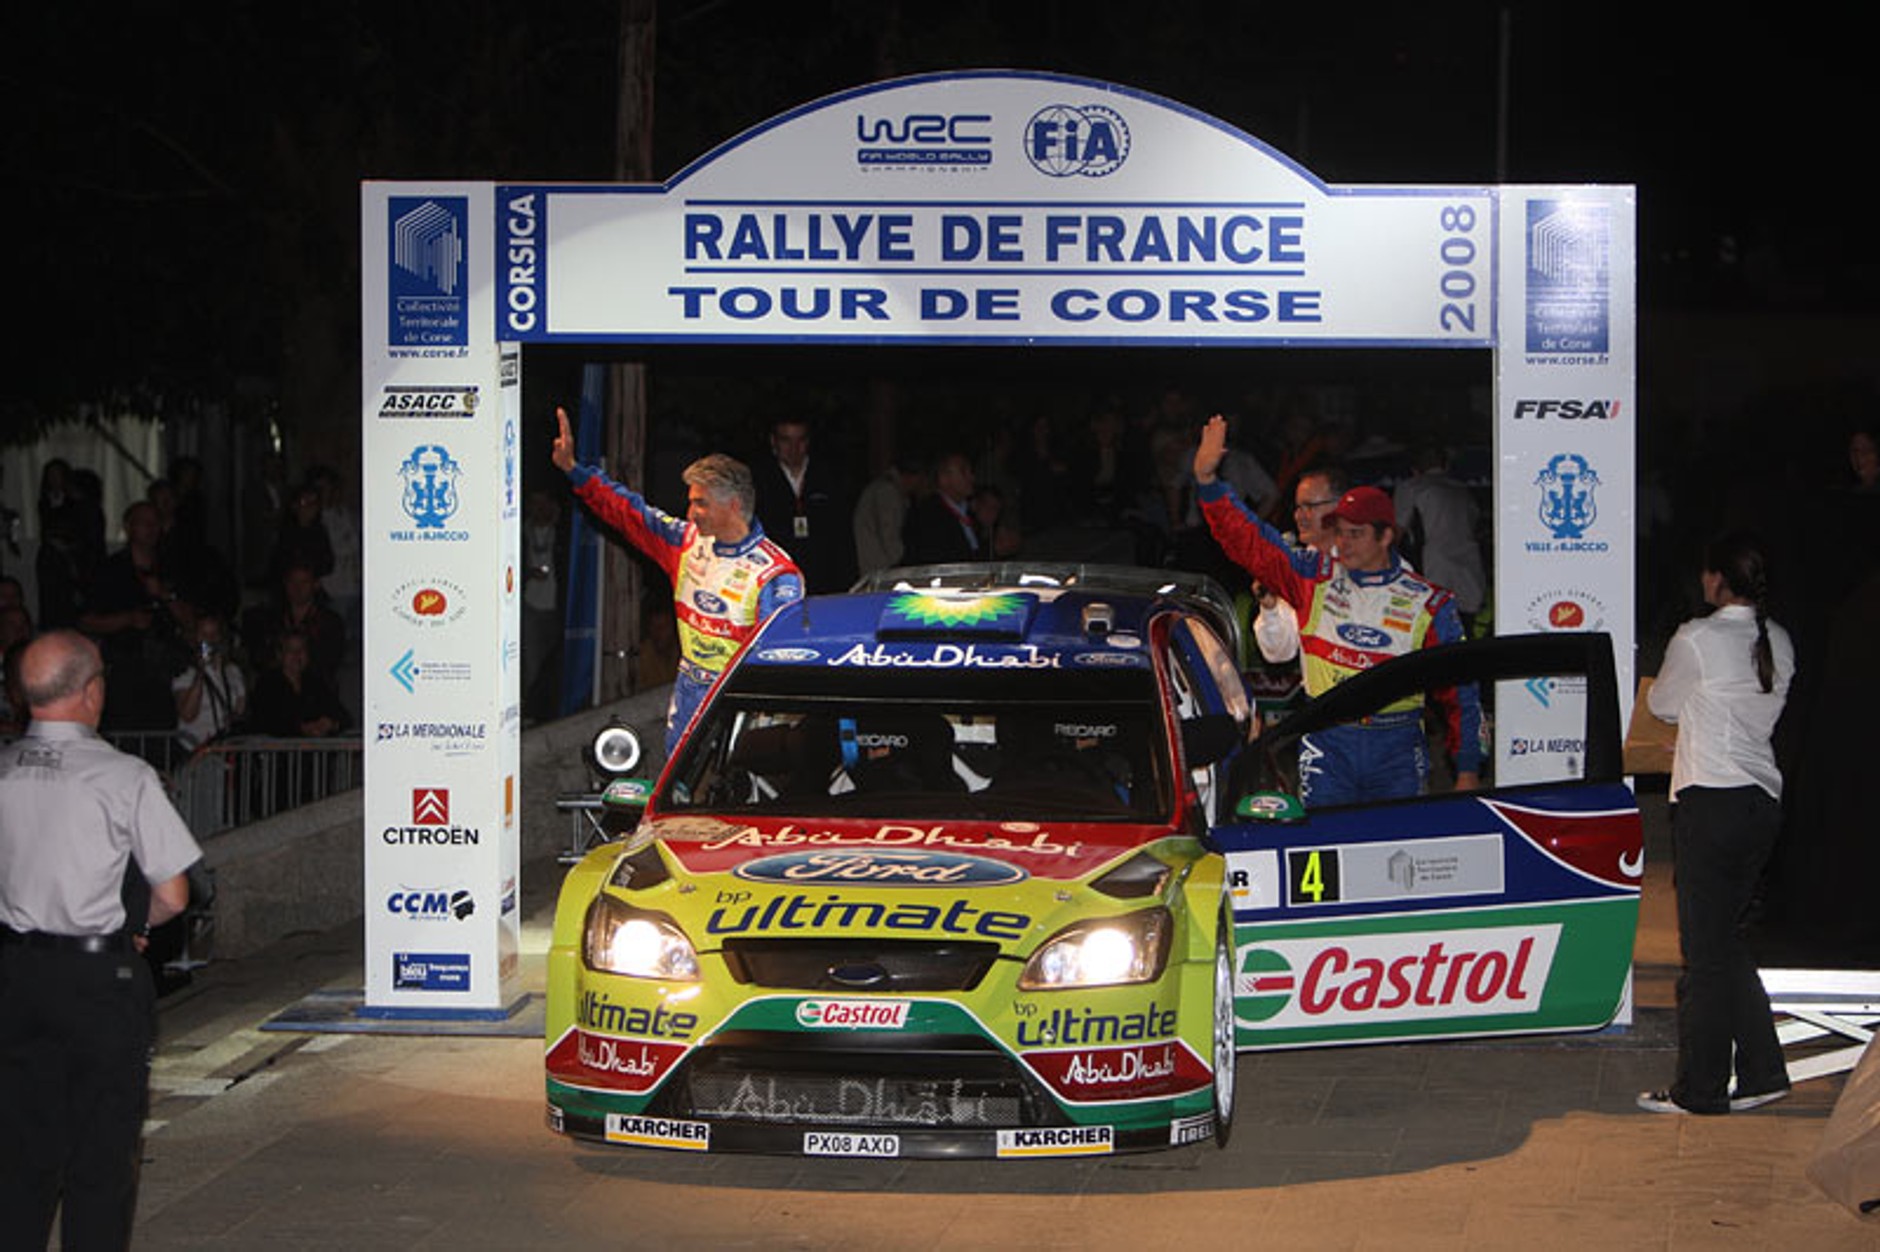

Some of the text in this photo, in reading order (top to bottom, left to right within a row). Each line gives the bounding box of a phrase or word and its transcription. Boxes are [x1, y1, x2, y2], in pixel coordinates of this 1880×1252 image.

[858, 115, 991, 143] WRC
[684, 213, 1305, 264] RALLYE DE FRANCE
[508, 194, 536, 332] CORSICA
[1440, 204, 1476, 332] 2008
[668, 286, 1322, 323] TOUR DE CORSE
[383, 394, 456, 409] ASACC
[1344, 628, 1381, 645] Ford
[857, 734, 908, 747] ECARO
[383, 825, 479, 845] CITROËN
[785, 852, 972, 883] Ford
[1300, 850, 1325, 903] 4
[387, 892, 448, 913] CCM
[706, 894, 1032, 940] ultimate
[1299, 936, 1535, 1016] Castrol
[820, 1003, 902, 1027] Castrol
[1017, 1002, 1178, 1046] ultimate
[619, 1116, 707, 1141] KÄRCHER
[1014, 1127, 1111, 1147] KÄRCHER
[807, 1134, 897, 1154] PX08 AXD
